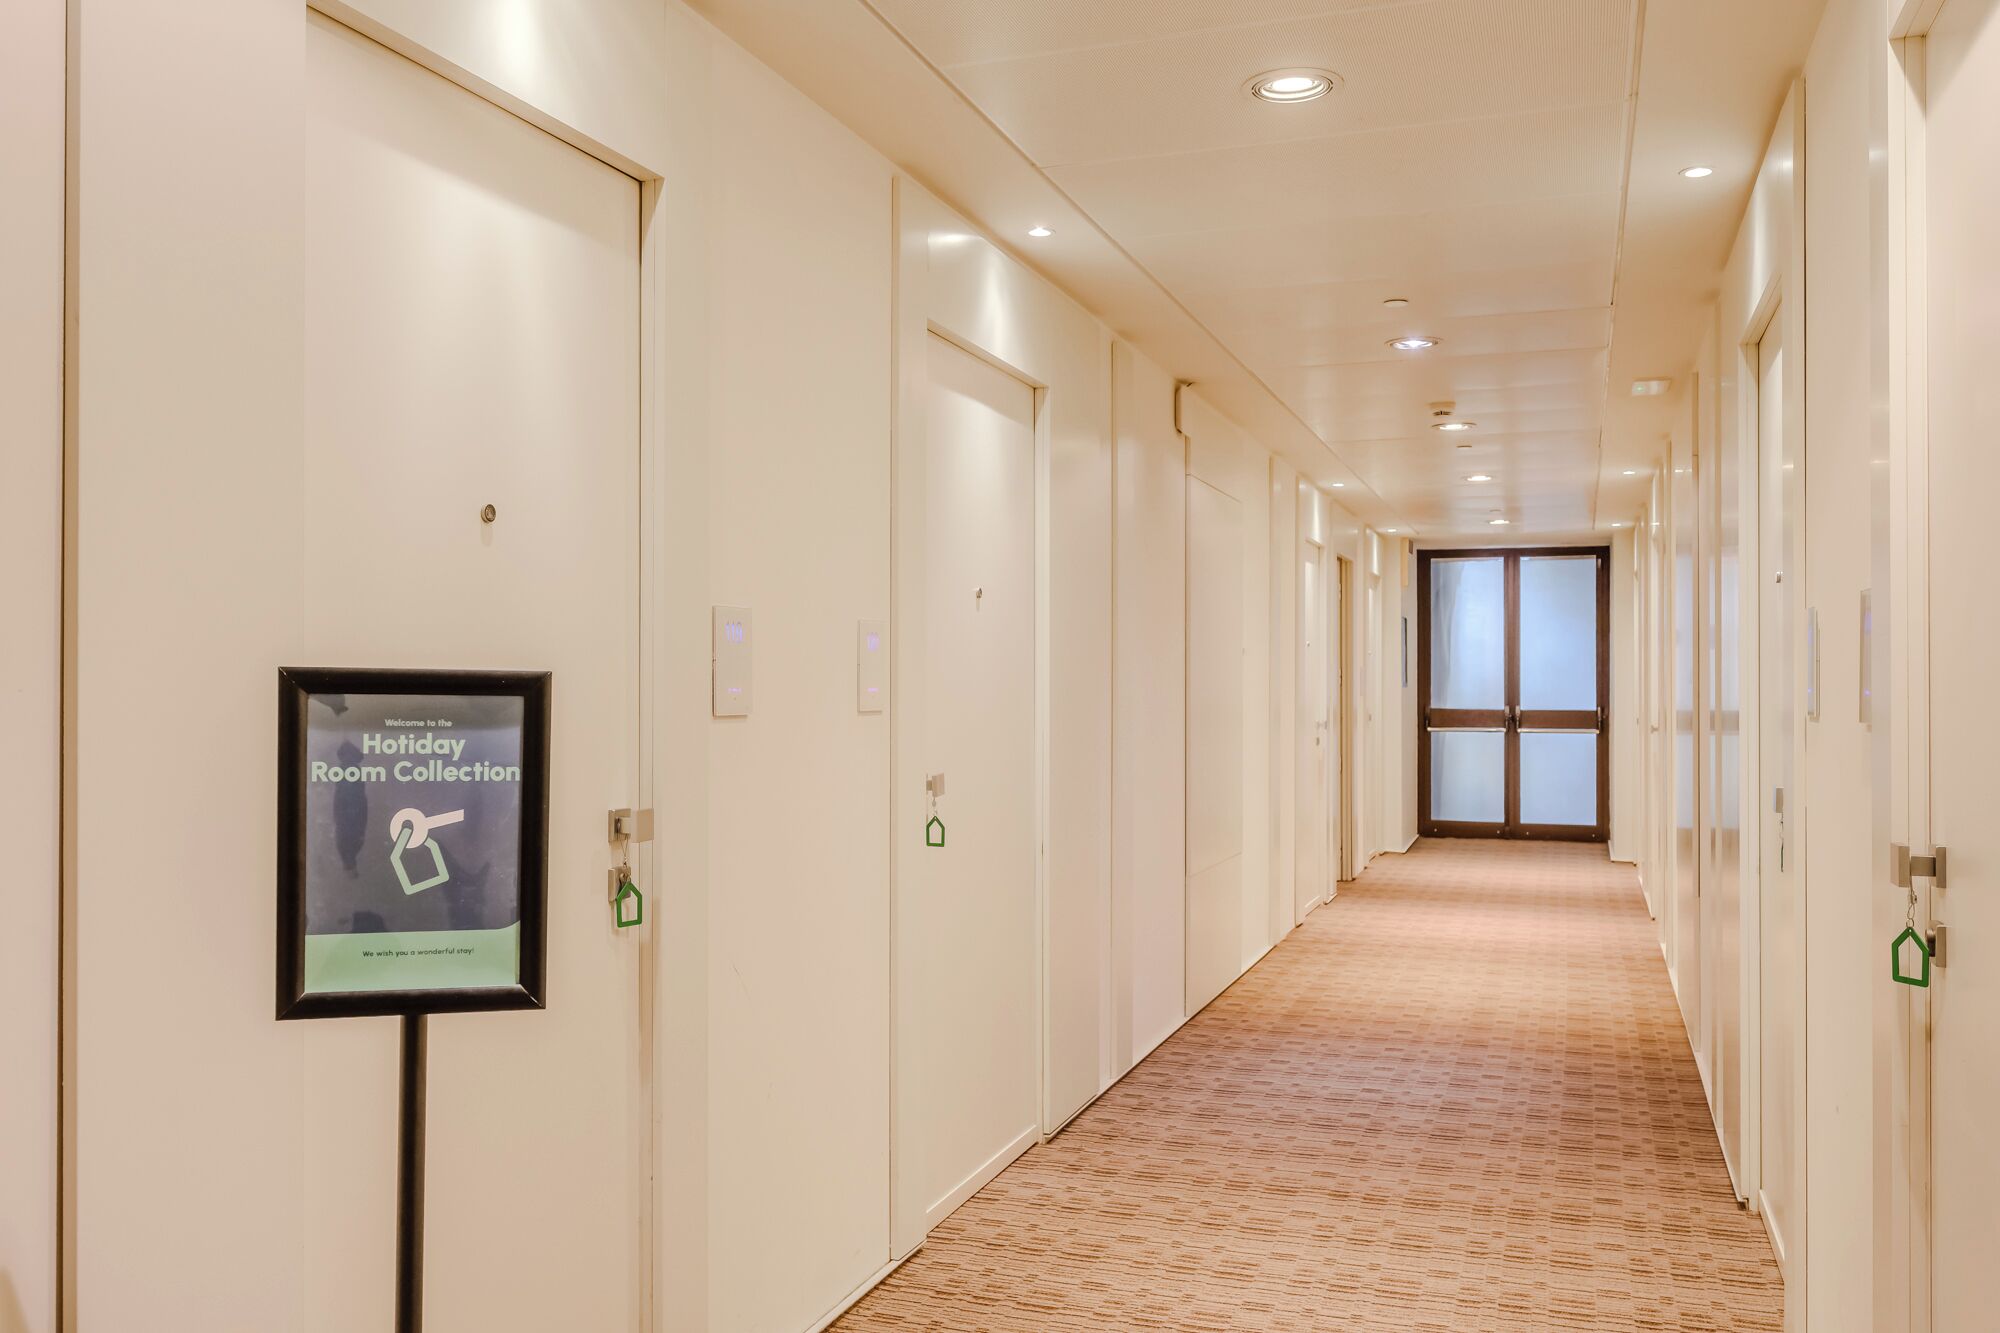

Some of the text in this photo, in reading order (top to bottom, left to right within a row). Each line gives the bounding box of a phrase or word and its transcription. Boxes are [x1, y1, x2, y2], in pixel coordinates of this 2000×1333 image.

[384, 718, 453, 727] Welcome to the
[362, 732, 466, 761] Hotiday
[311, 759, 520, 782] Room Collection
[395, 950, 409, 958] you
[418, 947, 455, 955] wonderful
[457, 947, 475, 956] stay!
